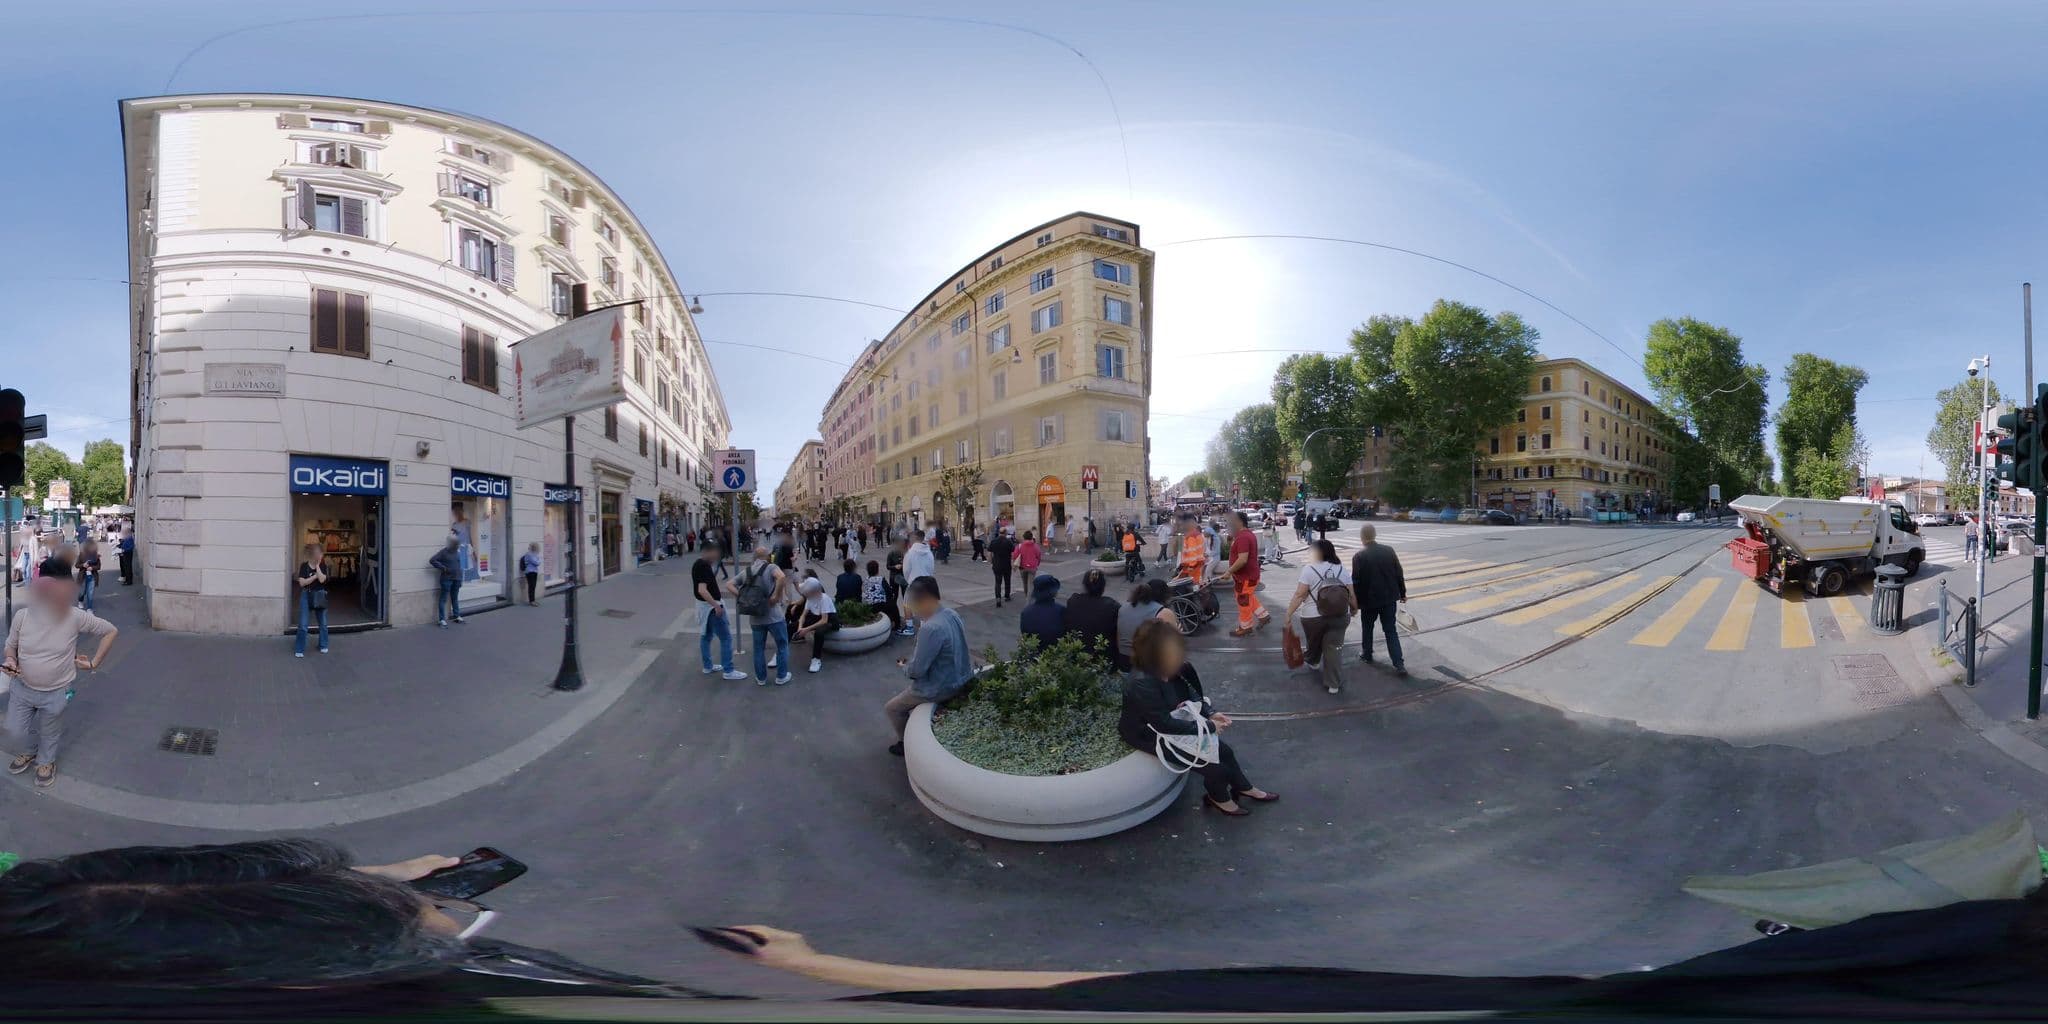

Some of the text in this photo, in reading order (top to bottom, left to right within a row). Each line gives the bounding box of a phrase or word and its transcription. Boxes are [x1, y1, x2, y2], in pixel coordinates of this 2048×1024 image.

[236, 368, 254, 377] VIA
[294, 466, 384, 489] okaïdi
[1083, 467, 1097, 479] M
[452, 476, 508, 496] okaïdi
